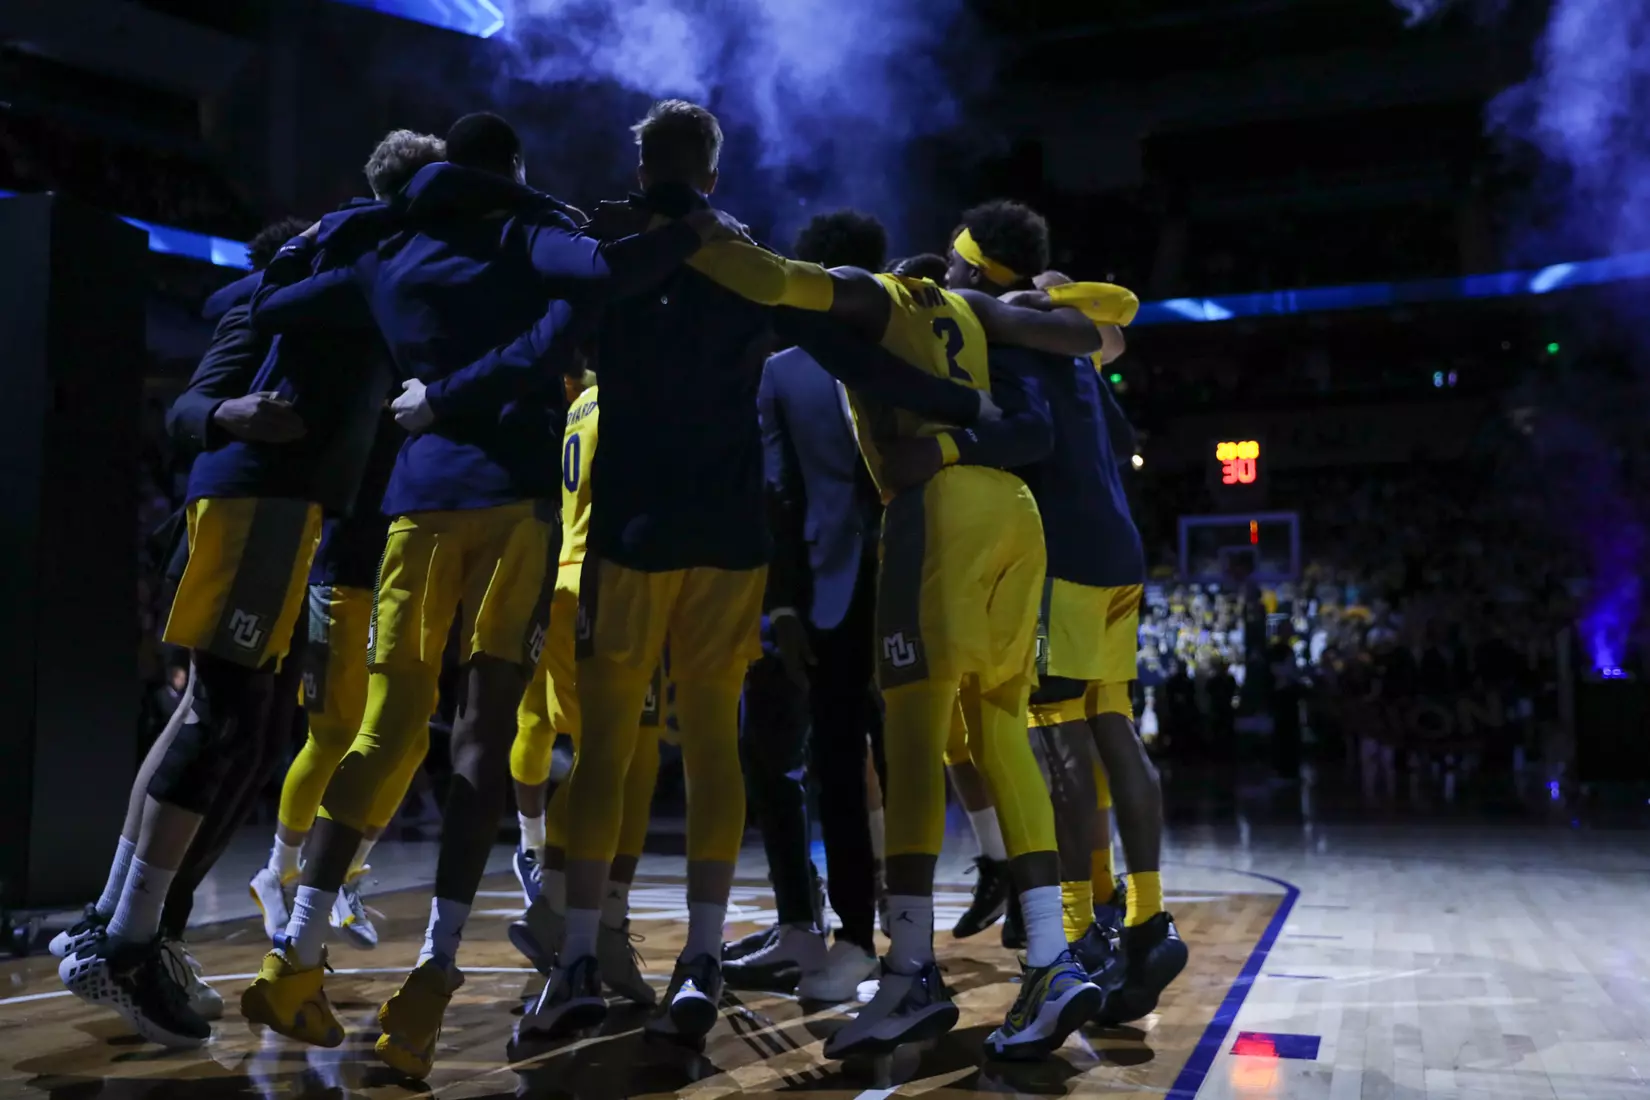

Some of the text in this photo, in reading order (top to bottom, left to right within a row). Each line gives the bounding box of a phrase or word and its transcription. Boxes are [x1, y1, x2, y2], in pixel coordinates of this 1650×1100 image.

[932, 317, 974, 381] 2
[564, 433, 580, 492] 0
[1221, 459, 1257, 484] 30
[228, 607, 262, 650] MU
[882, 631, 917, 668] MU
